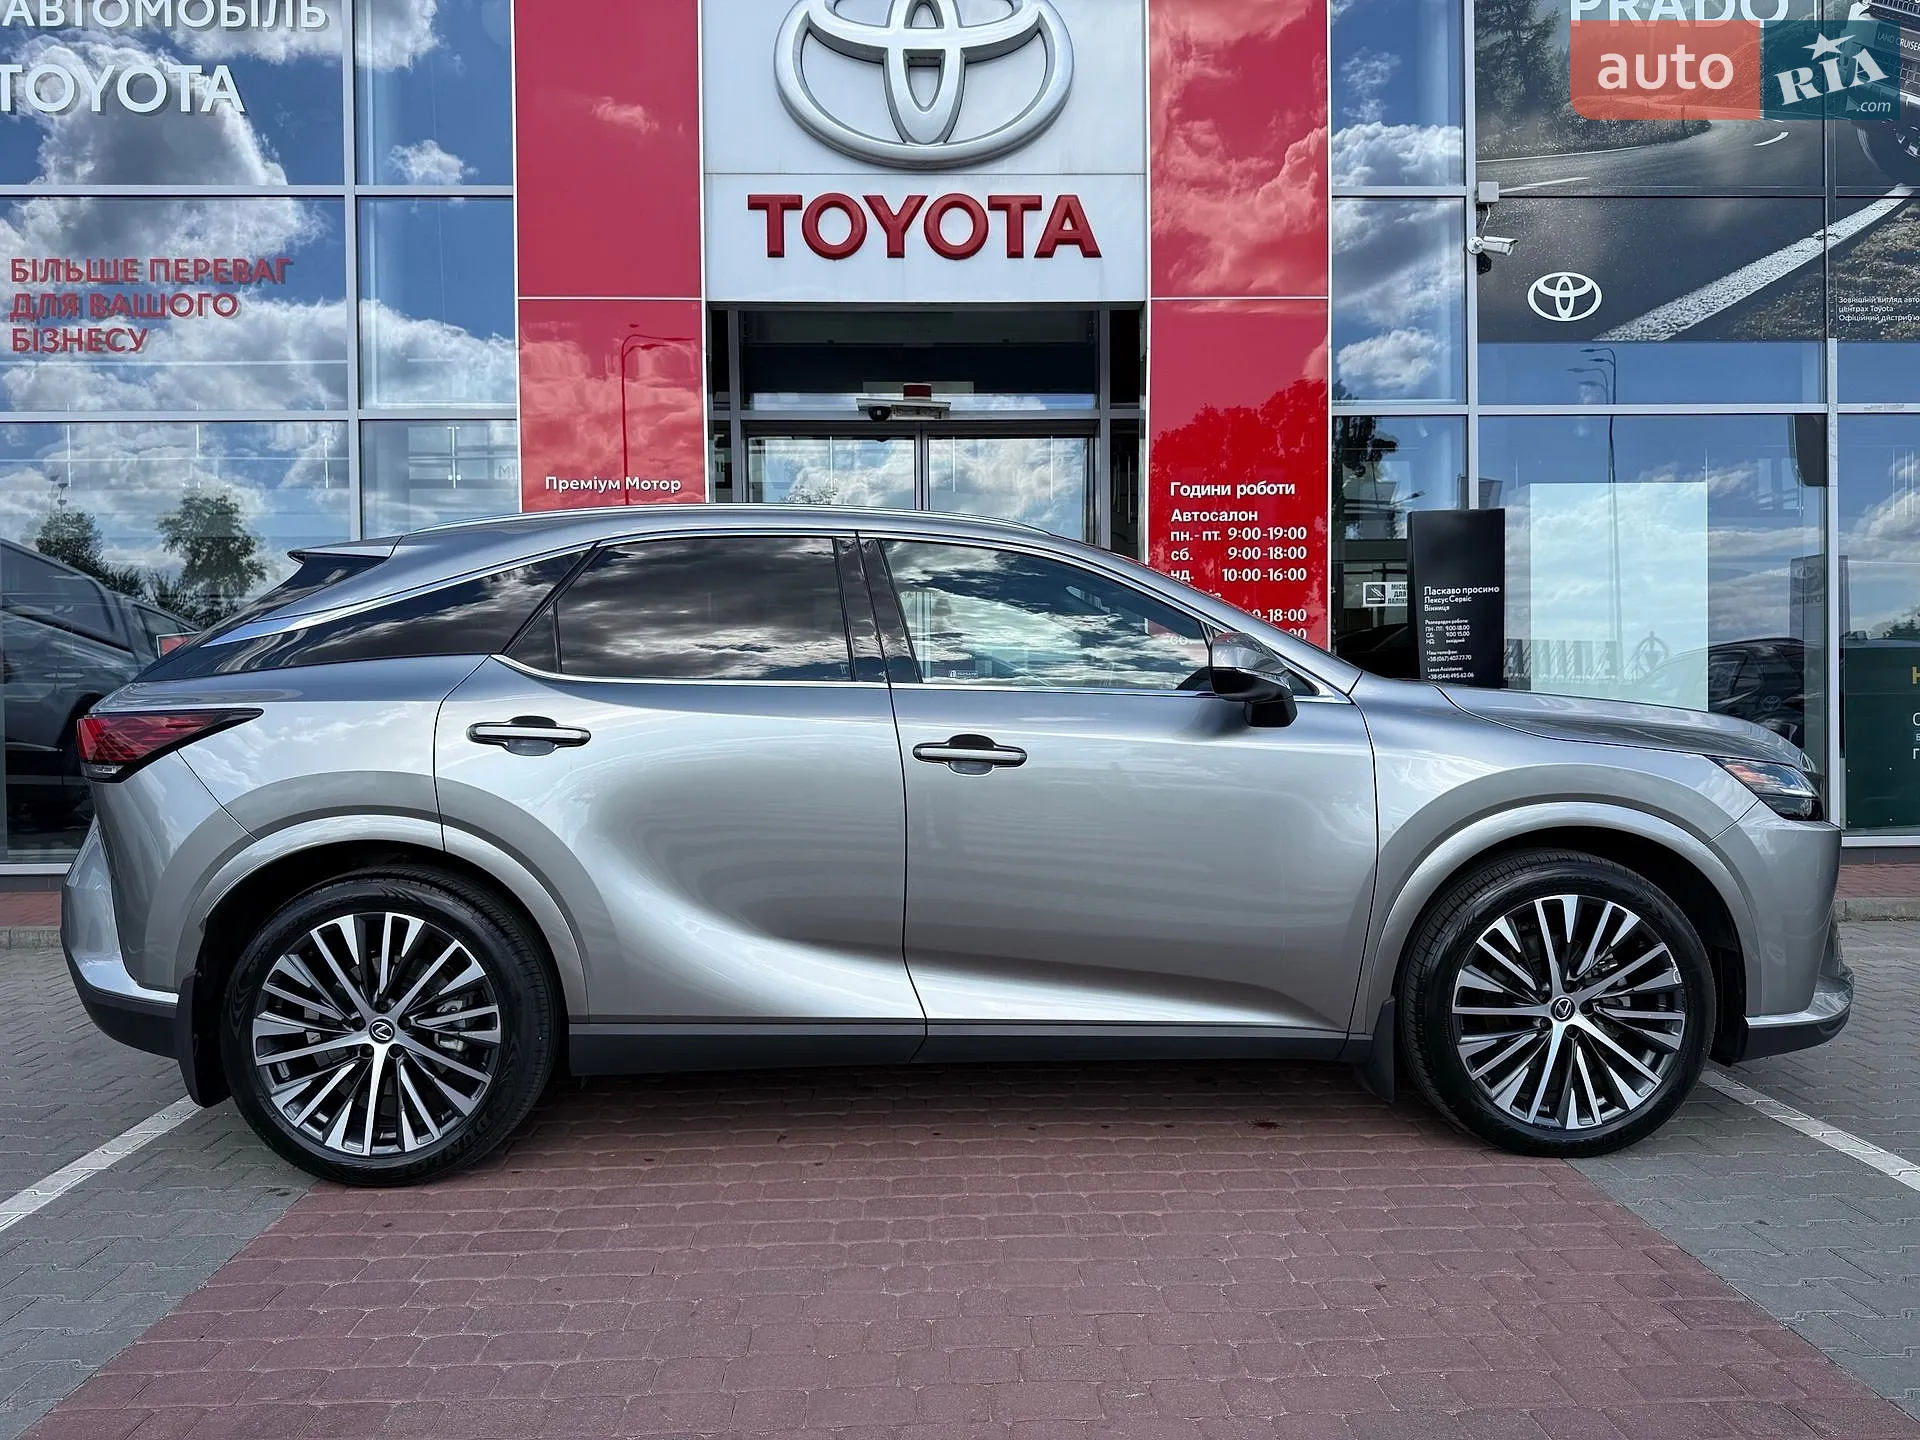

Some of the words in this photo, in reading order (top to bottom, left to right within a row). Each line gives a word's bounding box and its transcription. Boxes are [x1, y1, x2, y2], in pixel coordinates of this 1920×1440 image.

[0, 64, 246, 113] TOYOTA
[747, 192, 1103, 260] TOYOTA
[10, 257, 139, 284] БІЛЬШЕ
[149, 257, 292, 285] ПЕРЕВАГ
[9, 292, 79, 322] ДЛЯ
[89, 292, 239, 318] ВАШОГО
[11, 327, 149, 352] БІЗНЕСУ
[545, 475, 621, 494] Преміум
[625, 475, 682, 494] Мотор
[1170, 481, 1232, 498] Години
[1236, 480, 1296, 499] роботи
[1170, 508, 1259, 523] Автосалон
[1227, 526, 1308, 541] 9:00-19:00
[1170, 547, 1194, 561] сб.
[1227, 546, 1308, 561] 9:00-18:00
[1221, 567, 1308, 582] 10:00-16:00
[1424, 586, 1461, 596] Ласкаво
[1462, 586, 1500, 596] просимо
